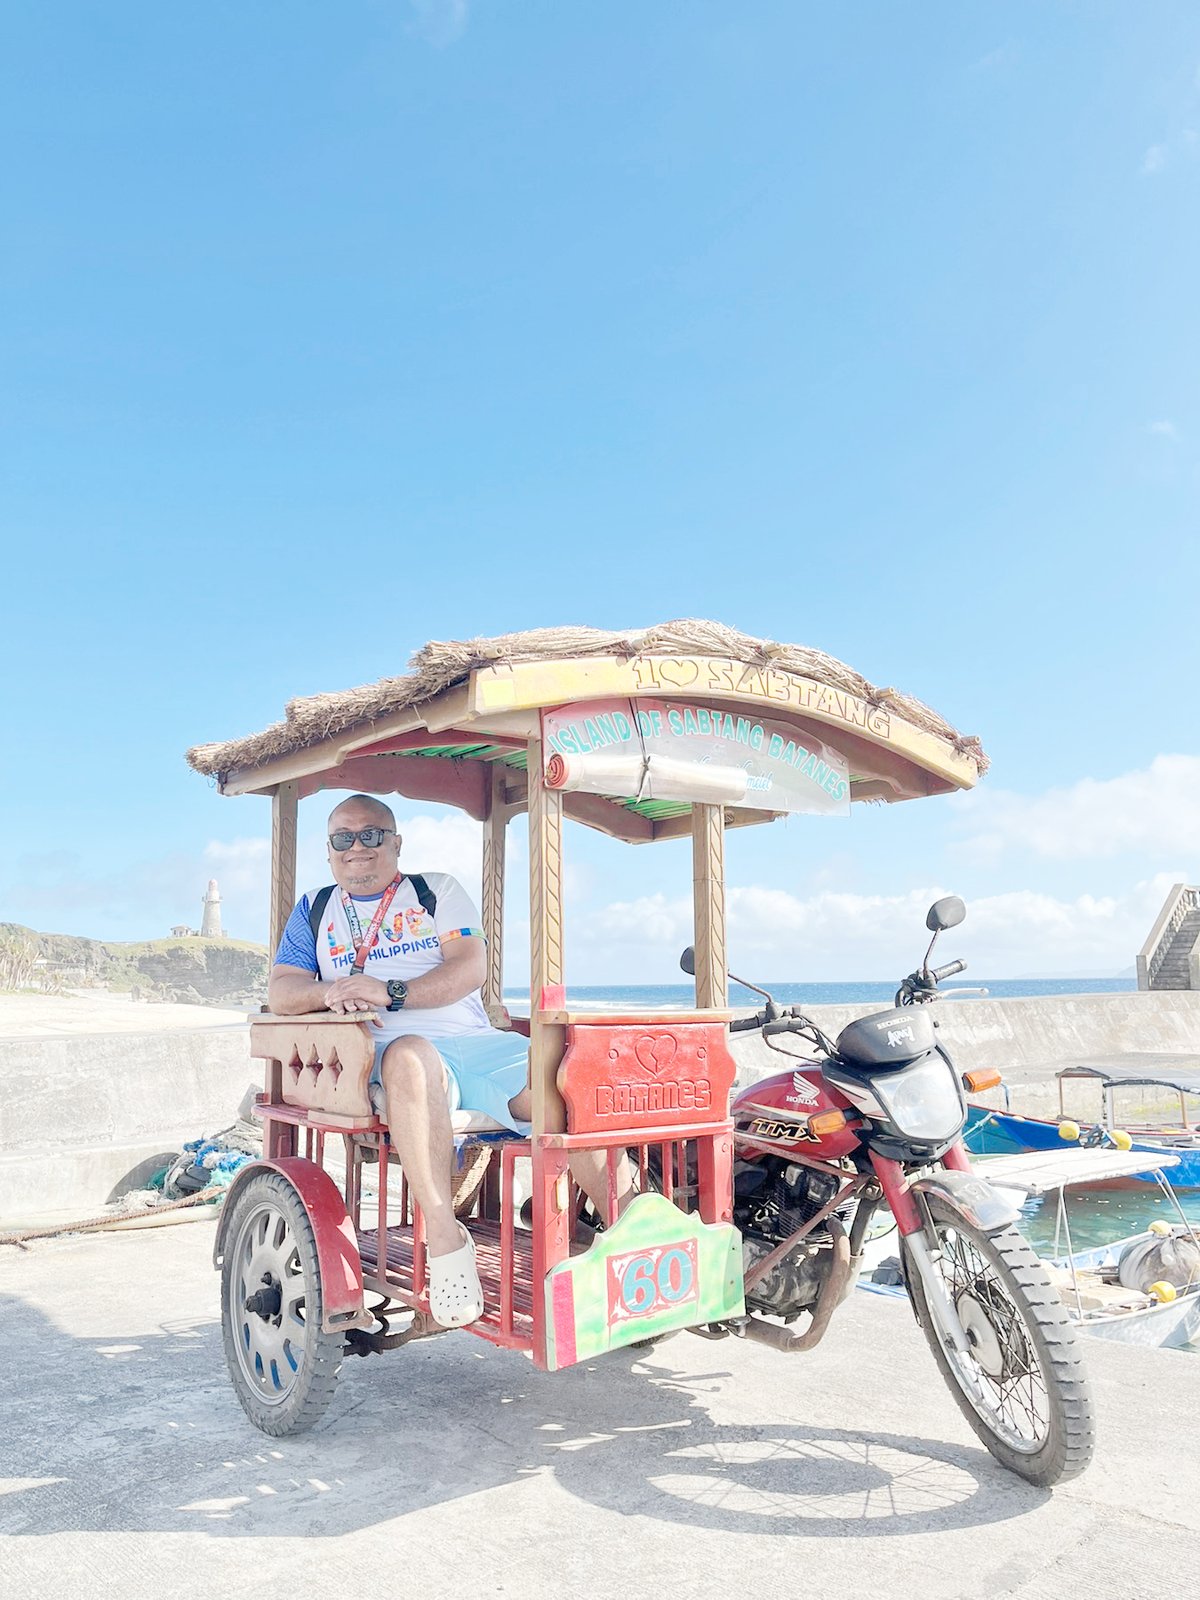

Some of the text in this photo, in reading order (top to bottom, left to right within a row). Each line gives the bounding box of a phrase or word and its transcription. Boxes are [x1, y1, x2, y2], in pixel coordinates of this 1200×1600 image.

[708, 659, 890, 739] SABTANG
[547, 711, 632, 754] ISLAND
[635, 709, 661, 738] OF
[667, 708, 765, 752] SABTANG
[767, 732, 848, 802] BATANES
[332, 936, 440, 969] THE HILIPPINES
[876, 1015, 915, 1030] HONDA
[786, 1095, 819, 1107] HONDA
[752, 1118, 823, 1144] TMX
[622, 1248, 693, 1313] 60
